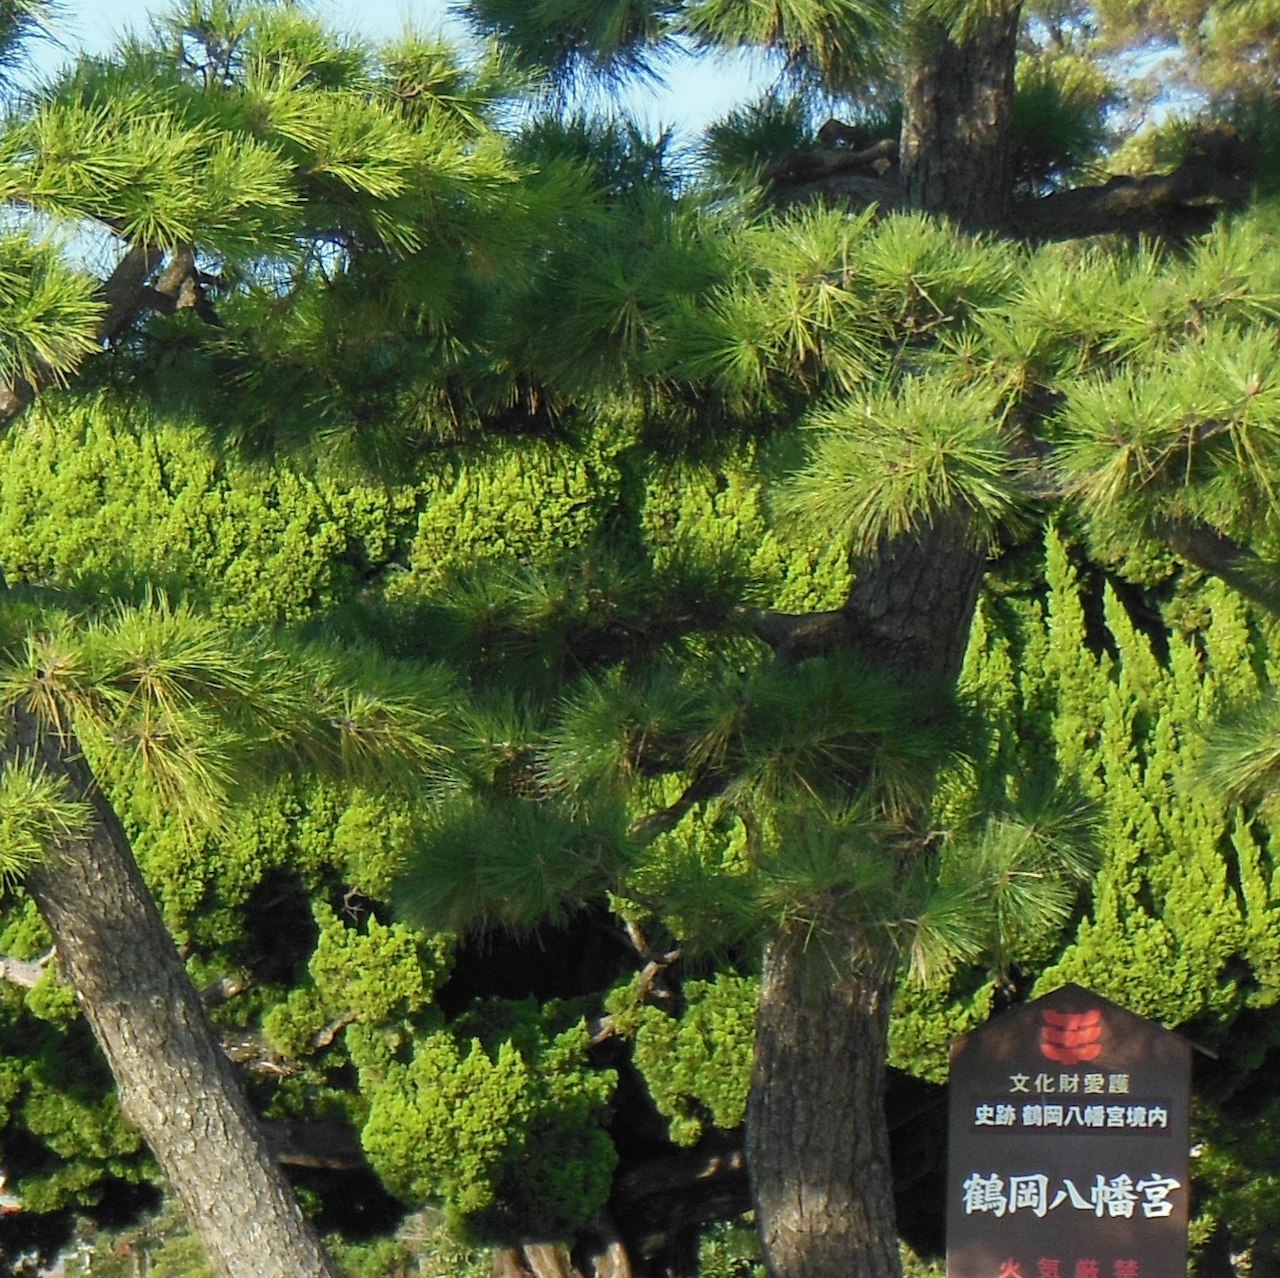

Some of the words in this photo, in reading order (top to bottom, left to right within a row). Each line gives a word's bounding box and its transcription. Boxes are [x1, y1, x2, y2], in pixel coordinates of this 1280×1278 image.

[1009, 1073, 1130, 1094] 文化財愛護
[974, 1104, 1017, 1126] 史跡
[1022, 1105, 1168, 1128] 鶴岡八幡宮境内
[961, 1173, 1181, 1218] 鶴岡八幡宮
